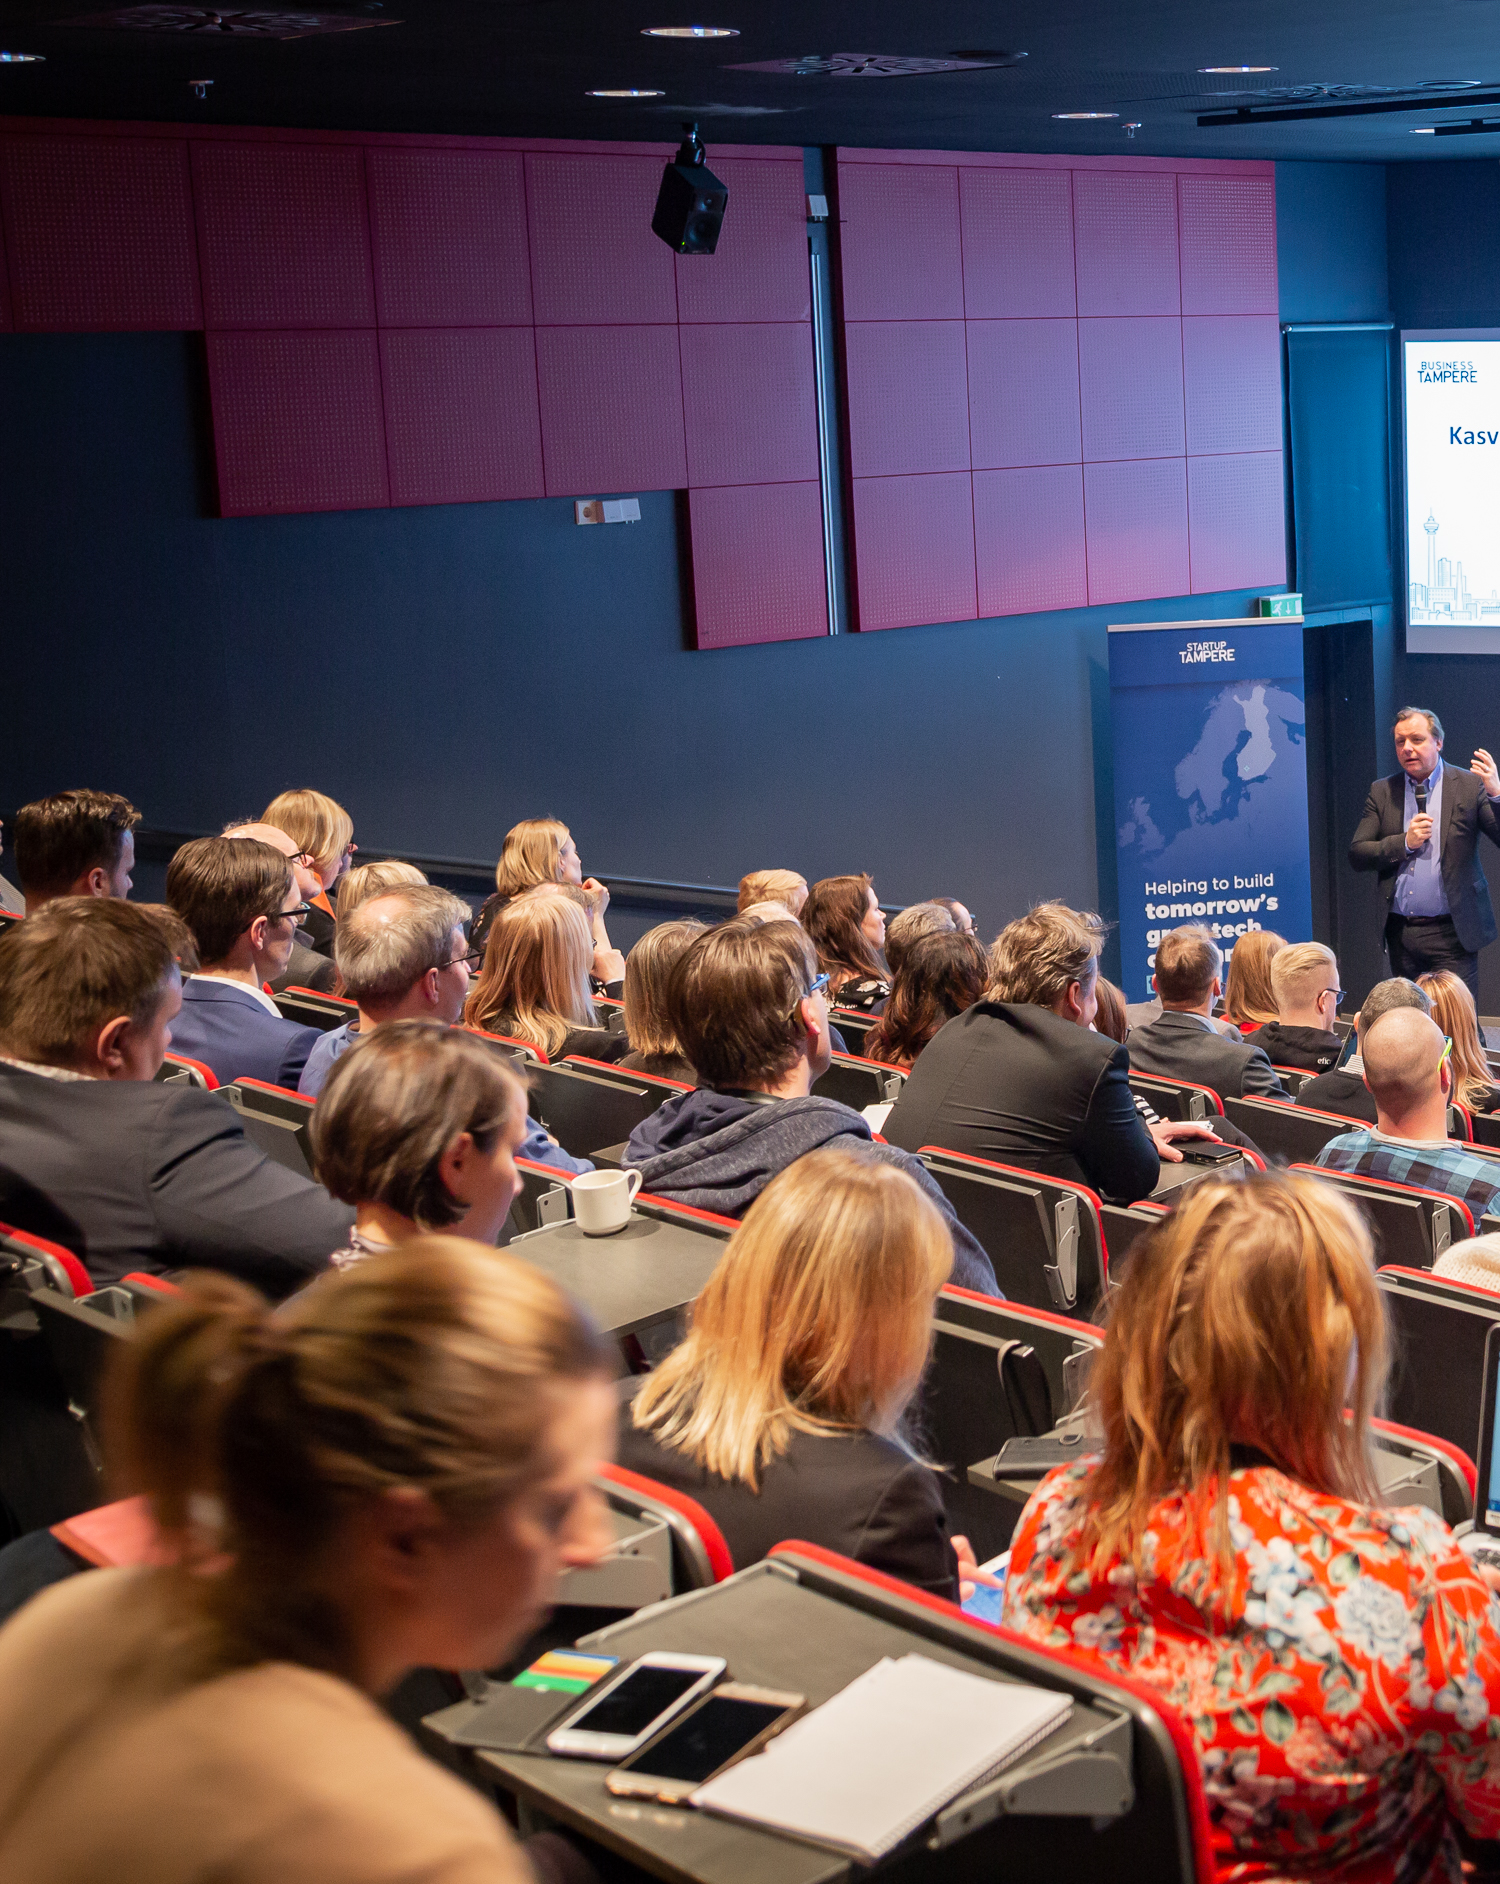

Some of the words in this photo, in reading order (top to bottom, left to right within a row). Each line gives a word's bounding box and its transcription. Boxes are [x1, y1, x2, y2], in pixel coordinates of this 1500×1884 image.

[1421, 360, 1474, 371] BUSINESS
[1417, 370, 1478, 383] TAMPERE
[1186, 641, 1227, 652] STARTUP
[1178, 649, 1236, 664] TAMPERE
[1145, 879, 1208, 896] Helping
[1212, 877, 1230, 890] to
[1234, 872, 1274, 889] build
